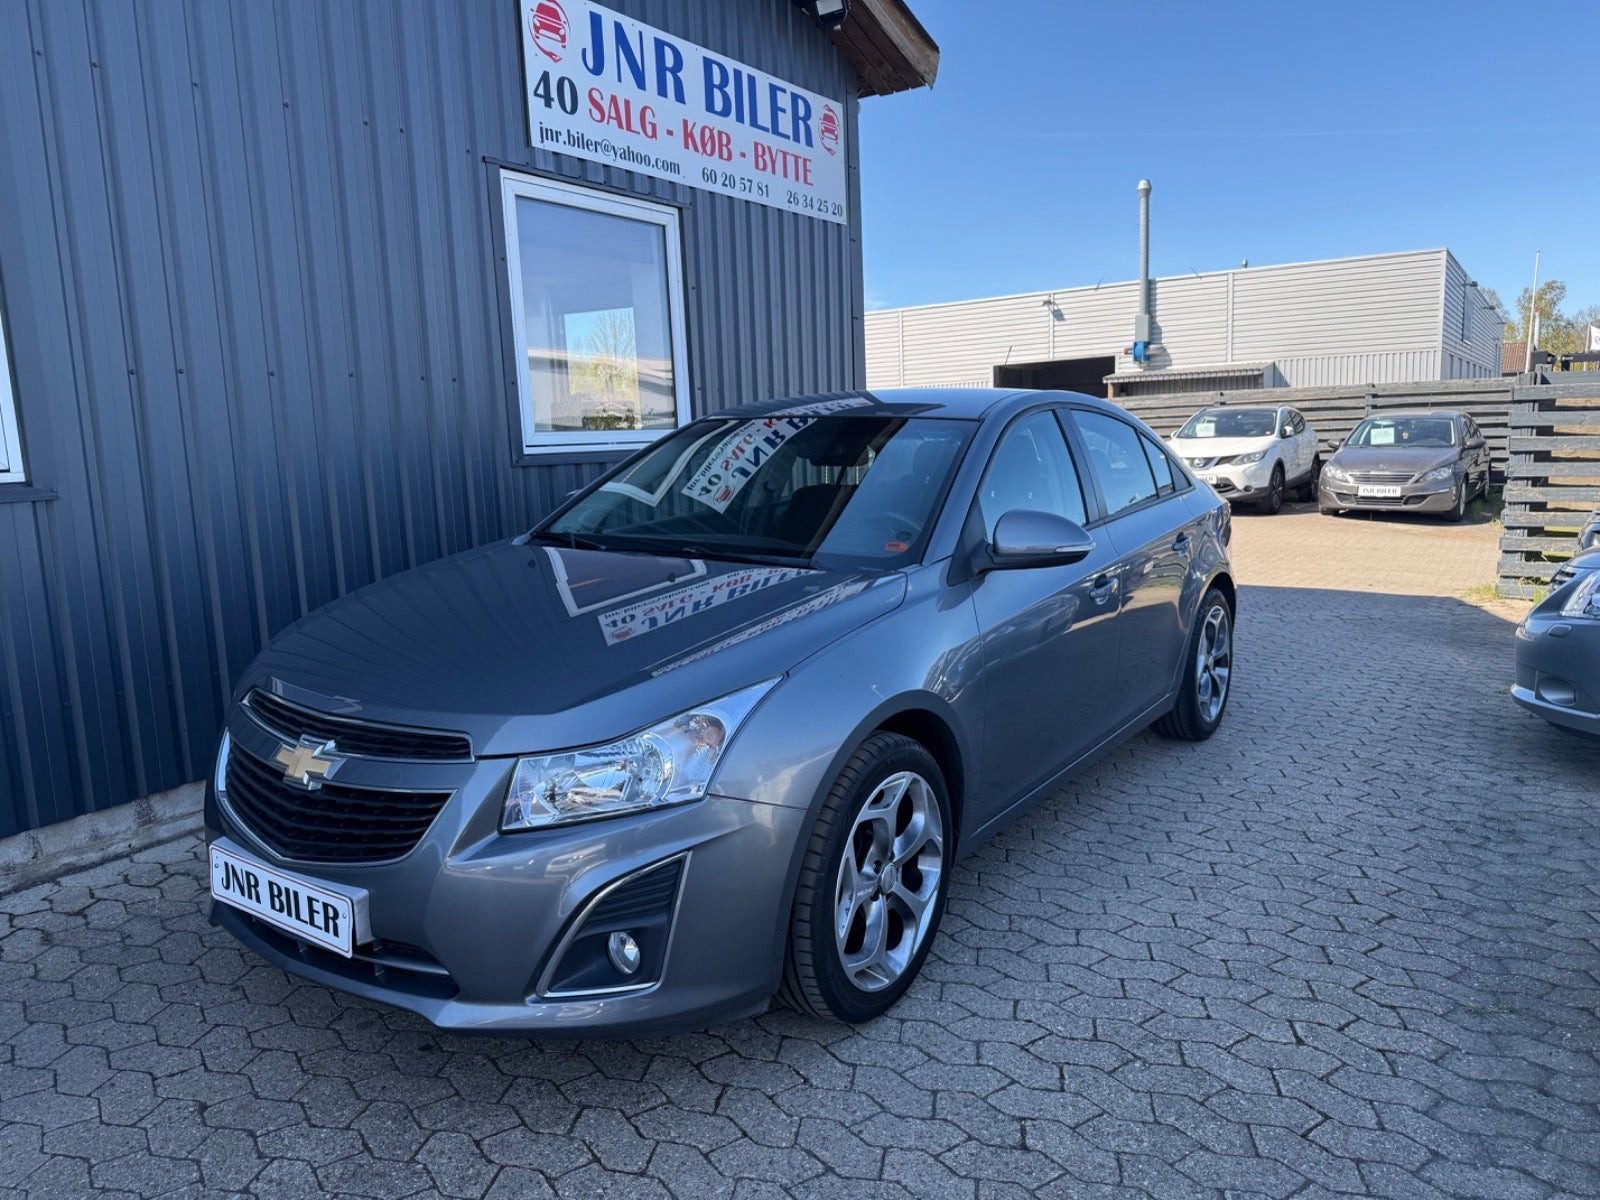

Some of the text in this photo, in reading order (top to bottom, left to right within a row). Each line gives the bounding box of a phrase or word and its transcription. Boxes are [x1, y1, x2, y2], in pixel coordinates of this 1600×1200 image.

[533, 70, 579, 115] 40
[581, 10, 814, 149] JNR BILER
[539, 121, 681, 175] jnr.biler@yahoo.com
[587, 87, 658, 140] SALG
[682, 118, 733, 162] KØB
[753, 141, 814, 186] BYTTE
[702, 167, 770, 198] 60 20 57 81
[786, 190, 844, 217] 26 34 25 20
[221, 861, 340, 939] JNR BILER
